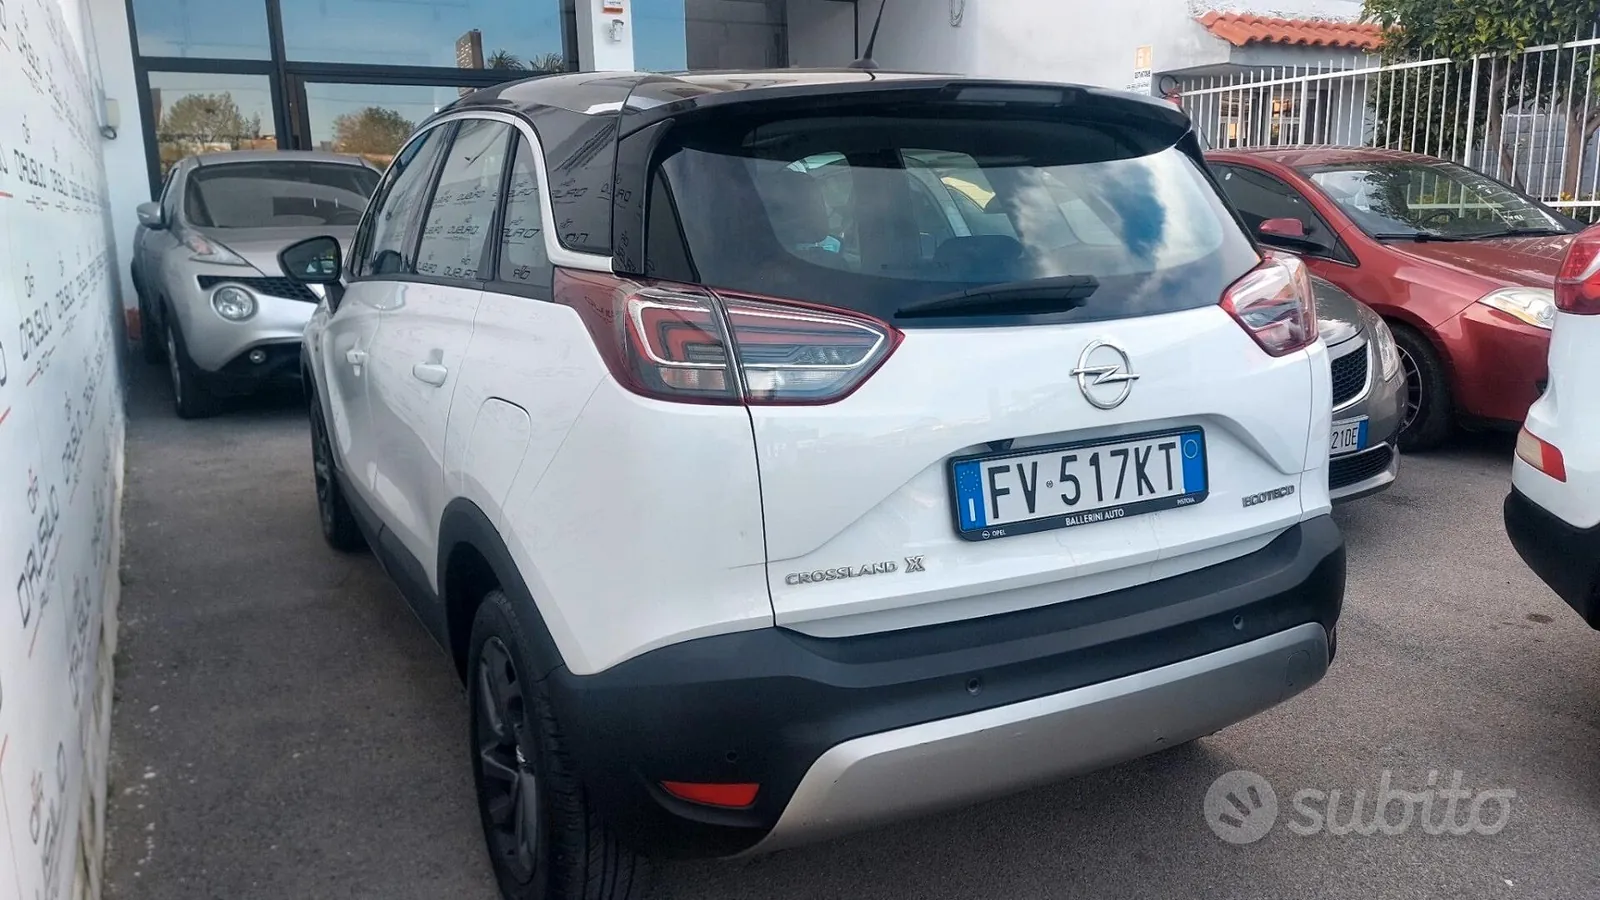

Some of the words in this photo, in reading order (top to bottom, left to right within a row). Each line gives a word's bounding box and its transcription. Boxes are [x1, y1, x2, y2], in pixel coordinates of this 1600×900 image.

[987, 461, 1039, 519] FV
[1059, 441, 1177, 506] 517KT
[1065, 512, 1104, 526] BALLERINI
[1104, 508, 1125, 522] AUTO
[991, 528, 1007, 537] OPEL
[785, 560, 899, 585] CROSSLAND
[905, 555, 925, 573] X
